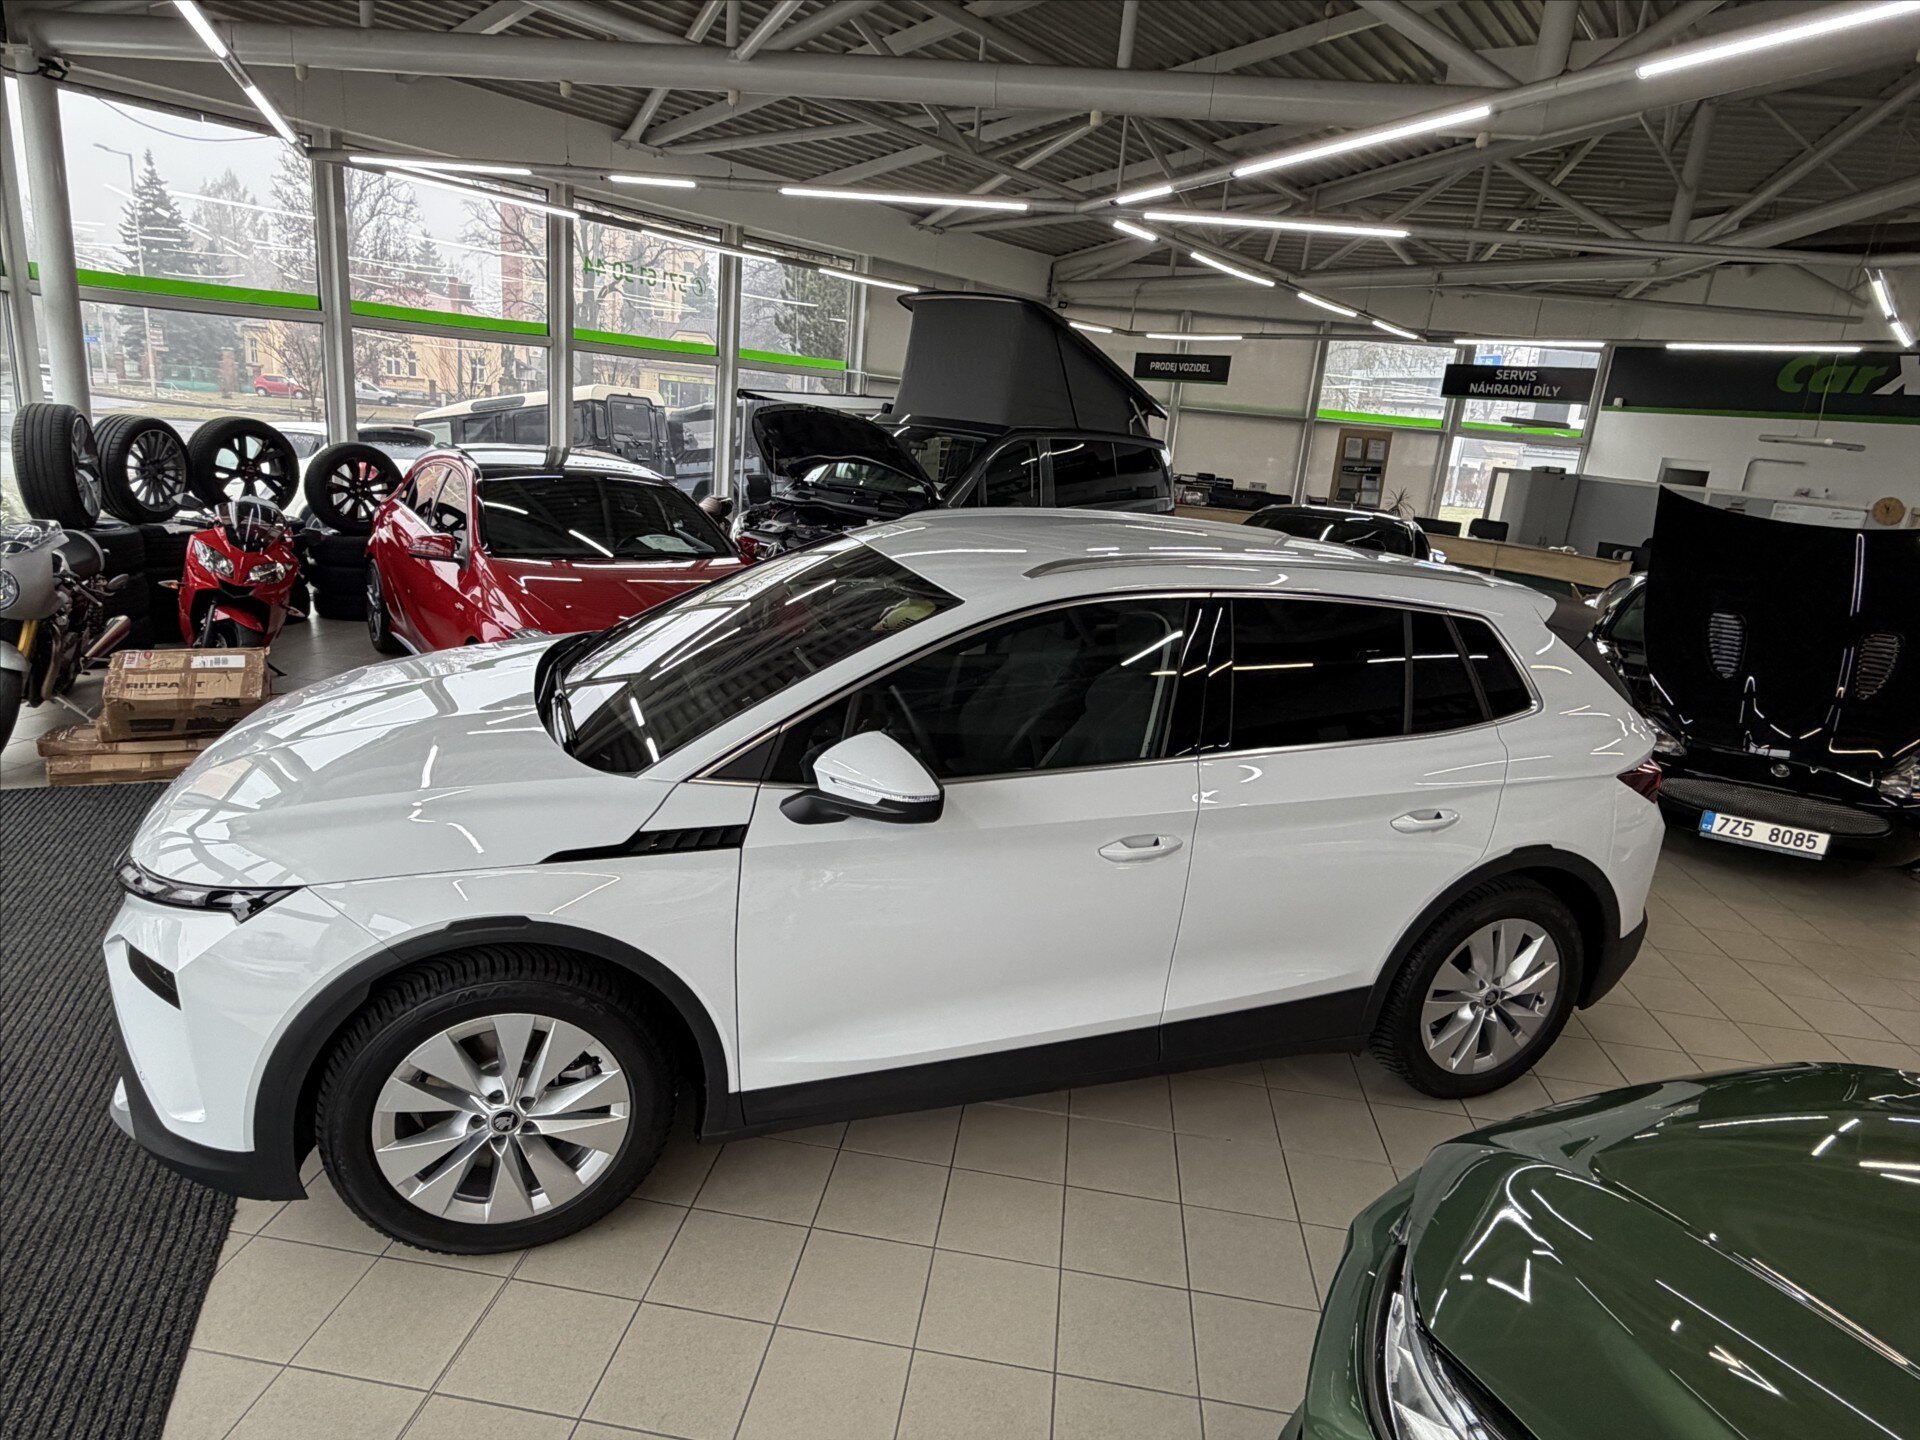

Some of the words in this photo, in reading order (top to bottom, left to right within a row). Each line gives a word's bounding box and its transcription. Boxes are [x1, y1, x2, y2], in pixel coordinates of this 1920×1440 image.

[1150, 361, 1178, 373] PRODEJ
[1179, 362, 1211, 373] VOZIDEL
[1495, 369, 1537, 381] SERVIS
[1469, 381, 1531, 396] NÁHRADNÍ
[1533, 383, 1561, 397] DÍLY
[1717, 816, 1755, 838] 7Z5
[1768, 827, 1819, 850] 8085
